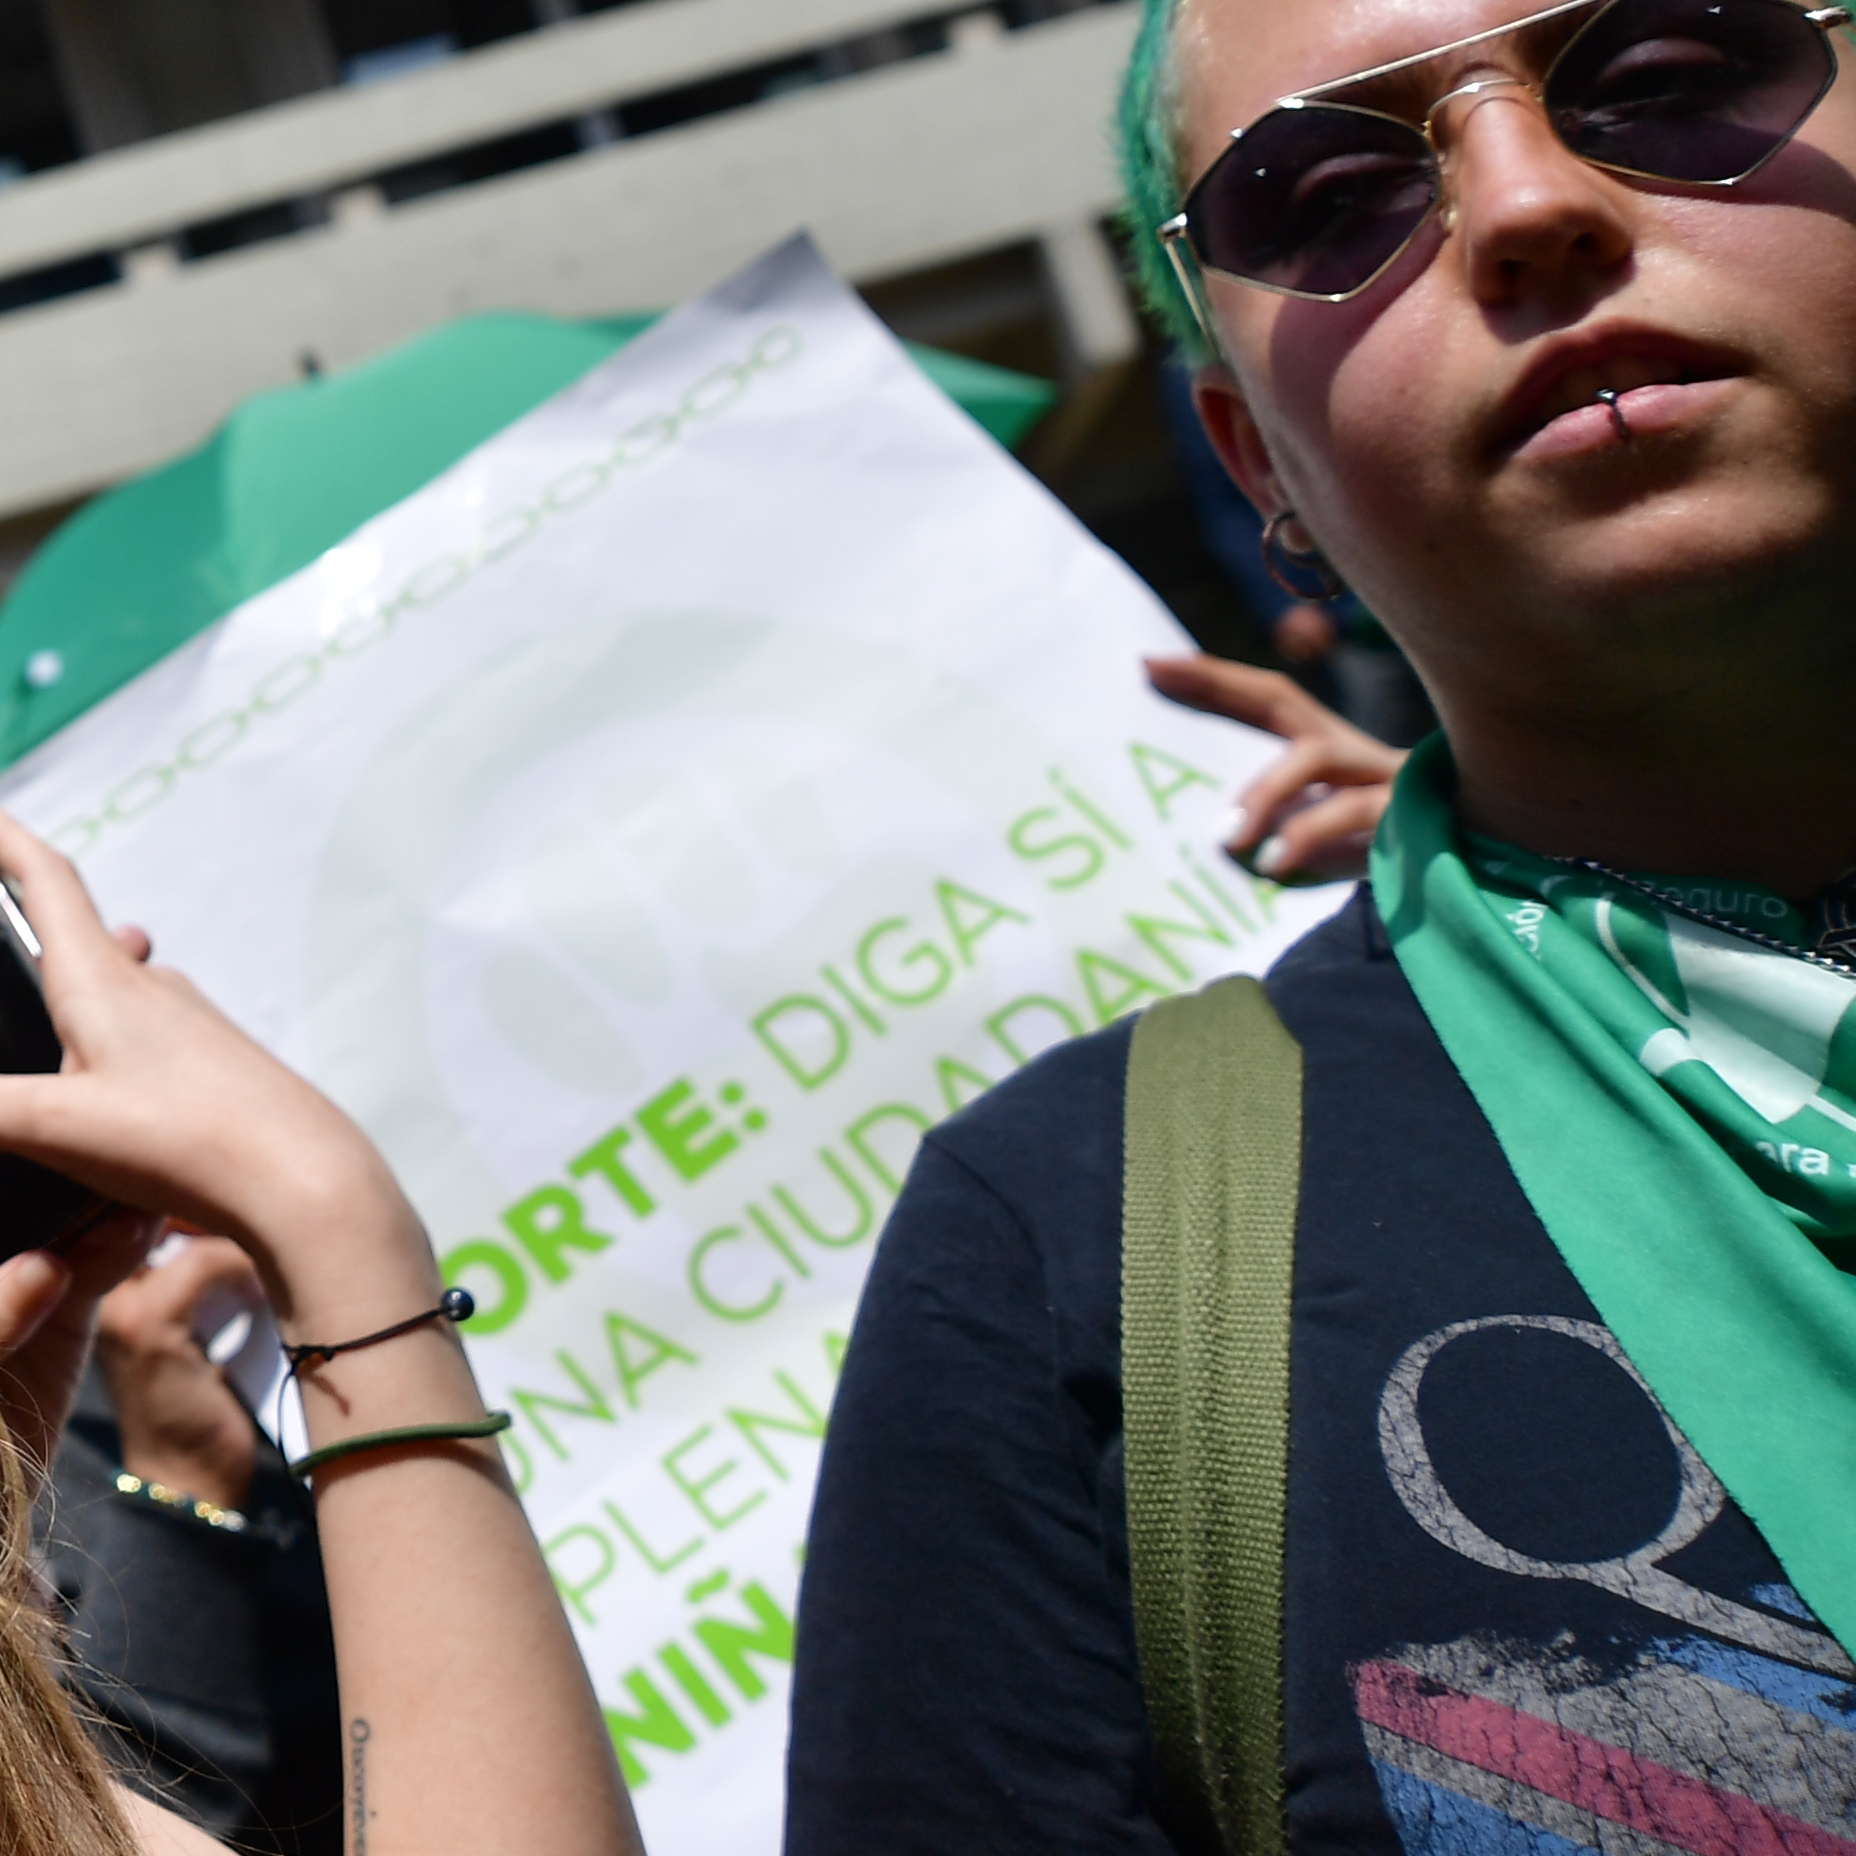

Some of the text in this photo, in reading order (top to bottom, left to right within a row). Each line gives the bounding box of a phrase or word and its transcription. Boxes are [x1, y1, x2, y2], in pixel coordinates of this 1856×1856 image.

[749, 876, 1032, 1092] DIGA
[1005, 766, 1133, 892] SÍ
[1129, 740, 1220, 823] A
[601, 1541, 807, 1791] NIÑ
